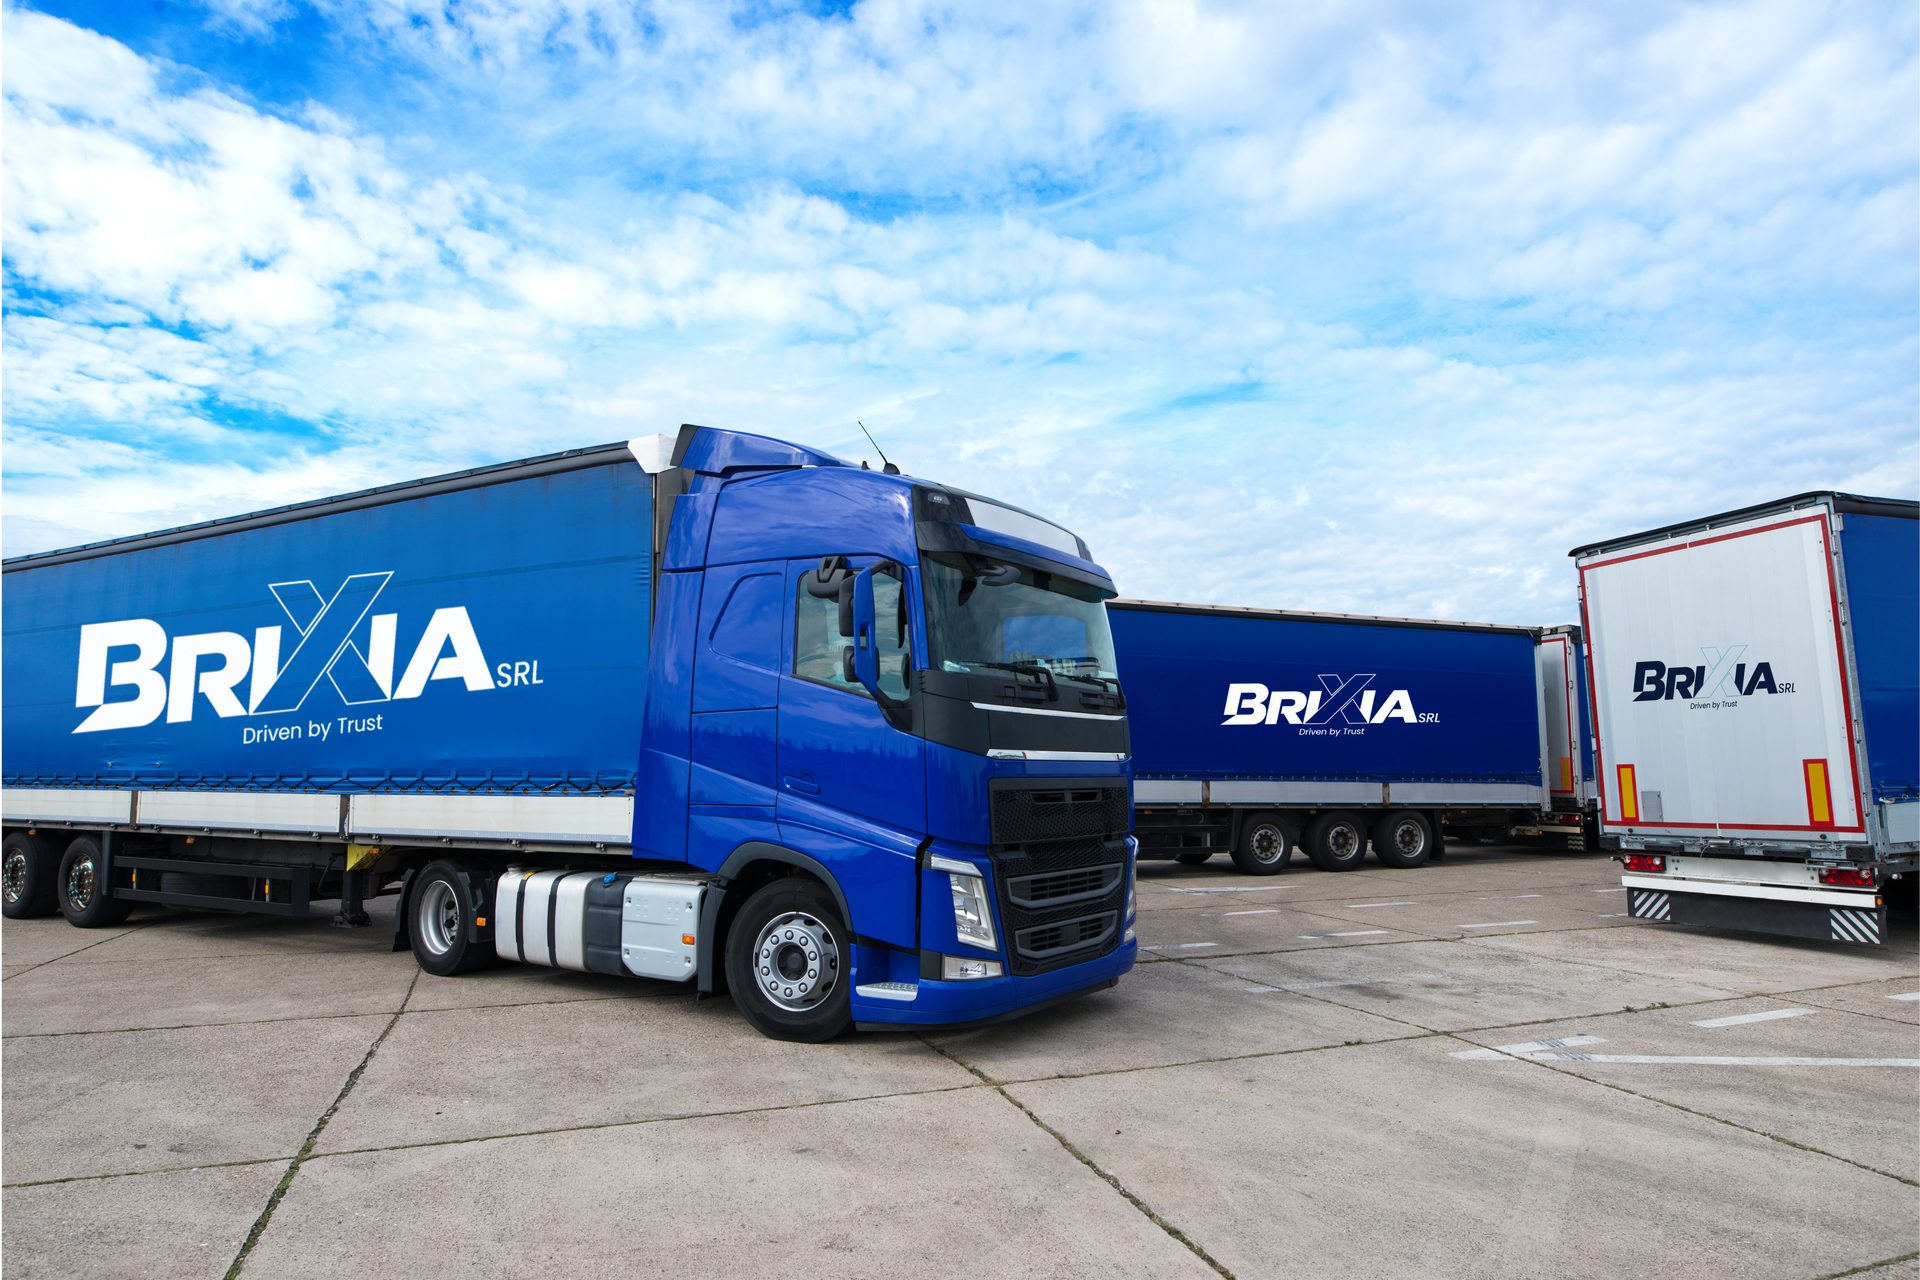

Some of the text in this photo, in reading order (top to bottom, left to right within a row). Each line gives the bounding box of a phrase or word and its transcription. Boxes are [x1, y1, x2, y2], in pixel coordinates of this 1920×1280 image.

[71, 570, 544, 734] BRIXIA SRL
[1778, 682, 1796, 693] SRL
[1220, 673, 1441, 726] BRIXIA SRL
[1690, 700, 1738, 710] Driven by Trust
[242, 714, 384, 744] Driven by Trust
[1298, 727, 1365, 737] Driven by Trust
